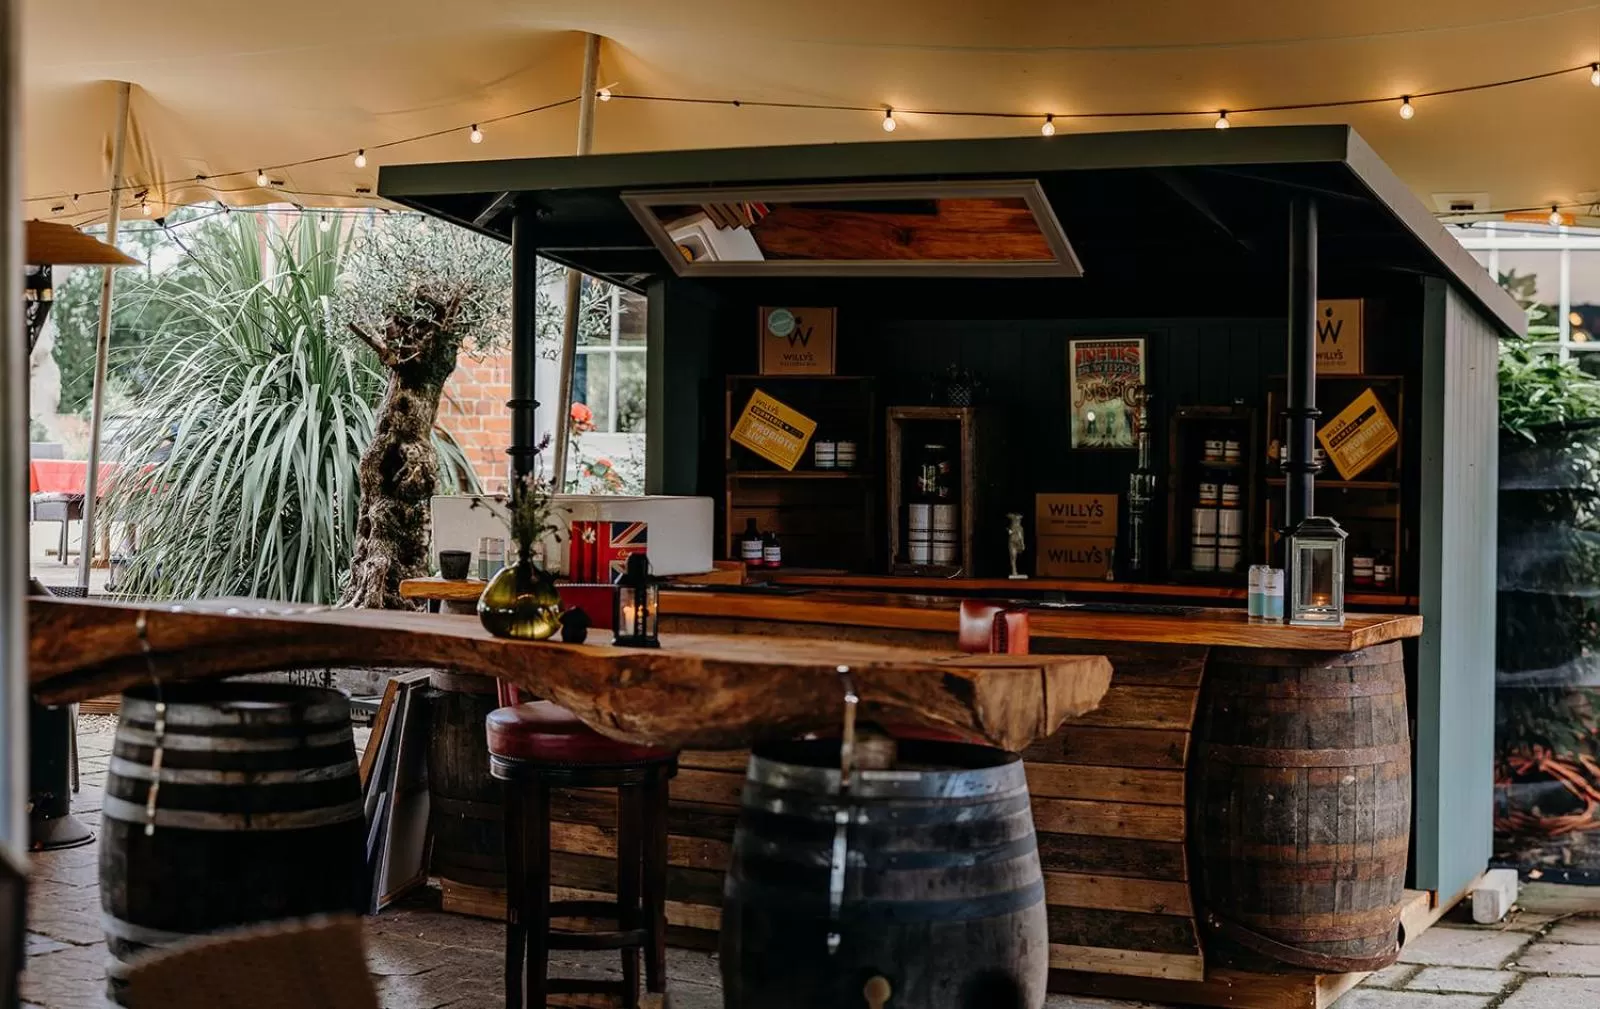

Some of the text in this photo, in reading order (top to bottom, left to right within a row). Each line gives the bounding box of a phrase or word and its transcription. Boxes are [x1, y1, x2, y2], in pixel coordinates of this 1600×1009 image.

[1048, 499, 1104, 518] WILLY'S
[1047, 546, 1103, 564] WILLY'S
[289, 667, 337, 688] CHASE
